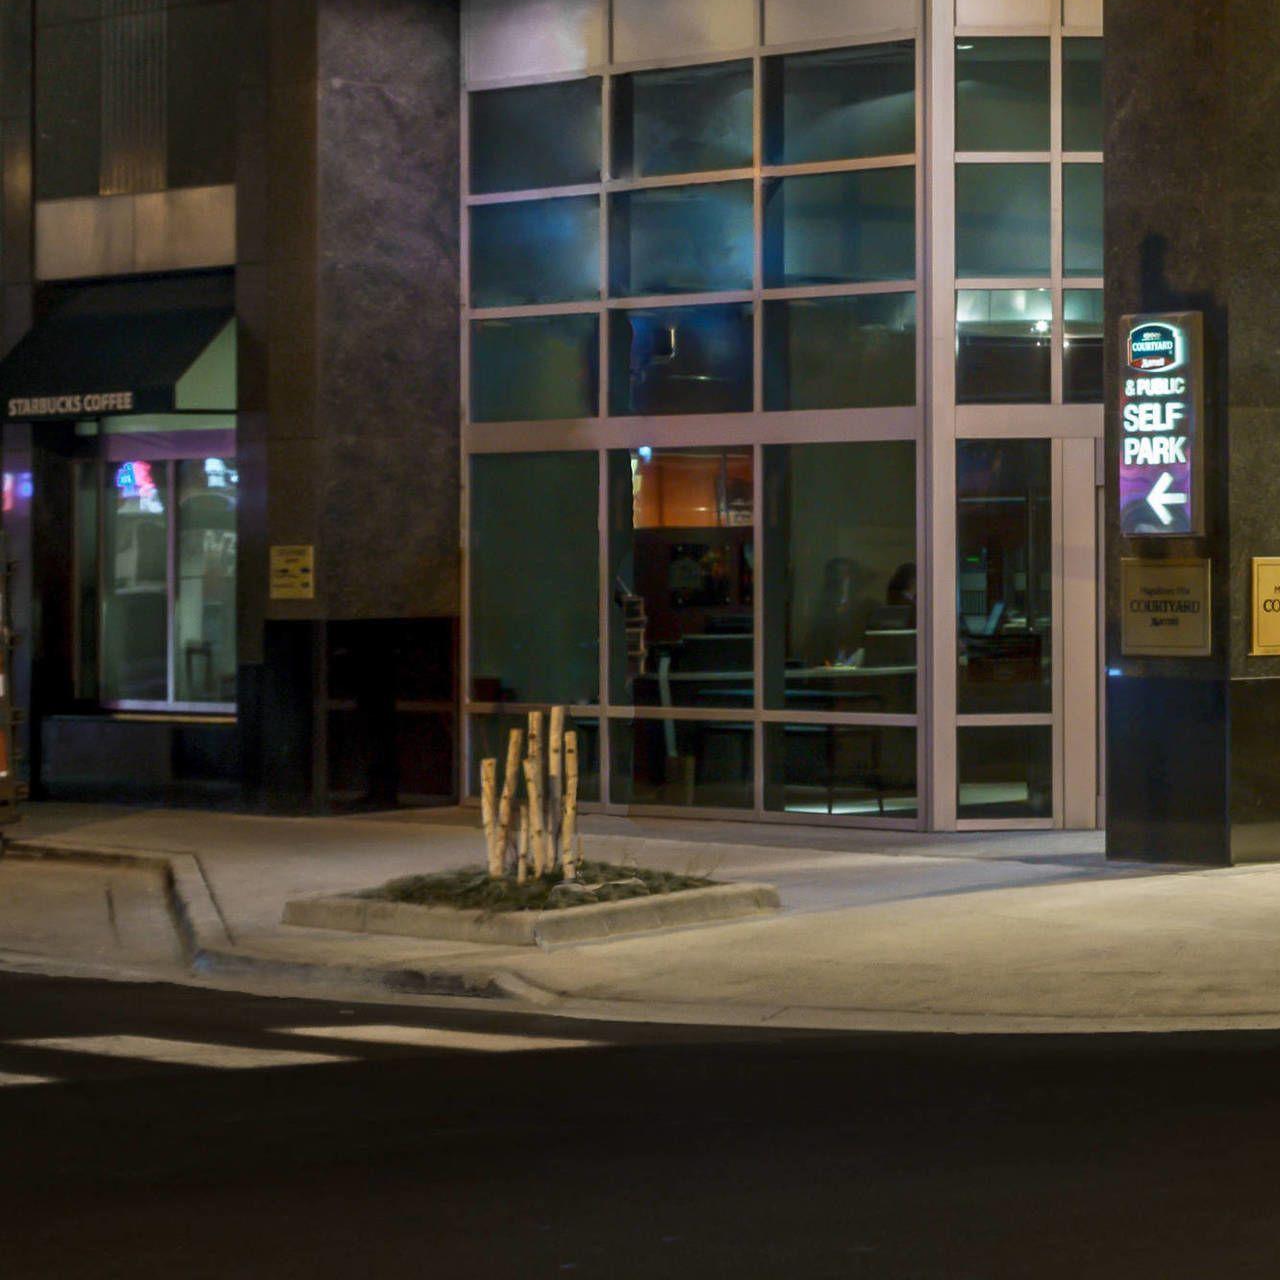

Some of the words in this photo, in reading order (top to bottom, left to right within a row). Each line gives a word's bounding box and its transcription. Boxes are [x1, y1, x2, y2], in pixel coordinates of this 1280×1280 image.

[1131, 340, 1174, 353] COURTYARD
[1124, 378, 1136, 397] &
[1136, 376, 1186, 396] PUBLIC
[8, 395, 81, 417] STARBUCKS
[83, 391, 133, 413] COFFEE
[1123, 401, 1185, 433] SELF
[1123, 435, 1187, 466] PARK
